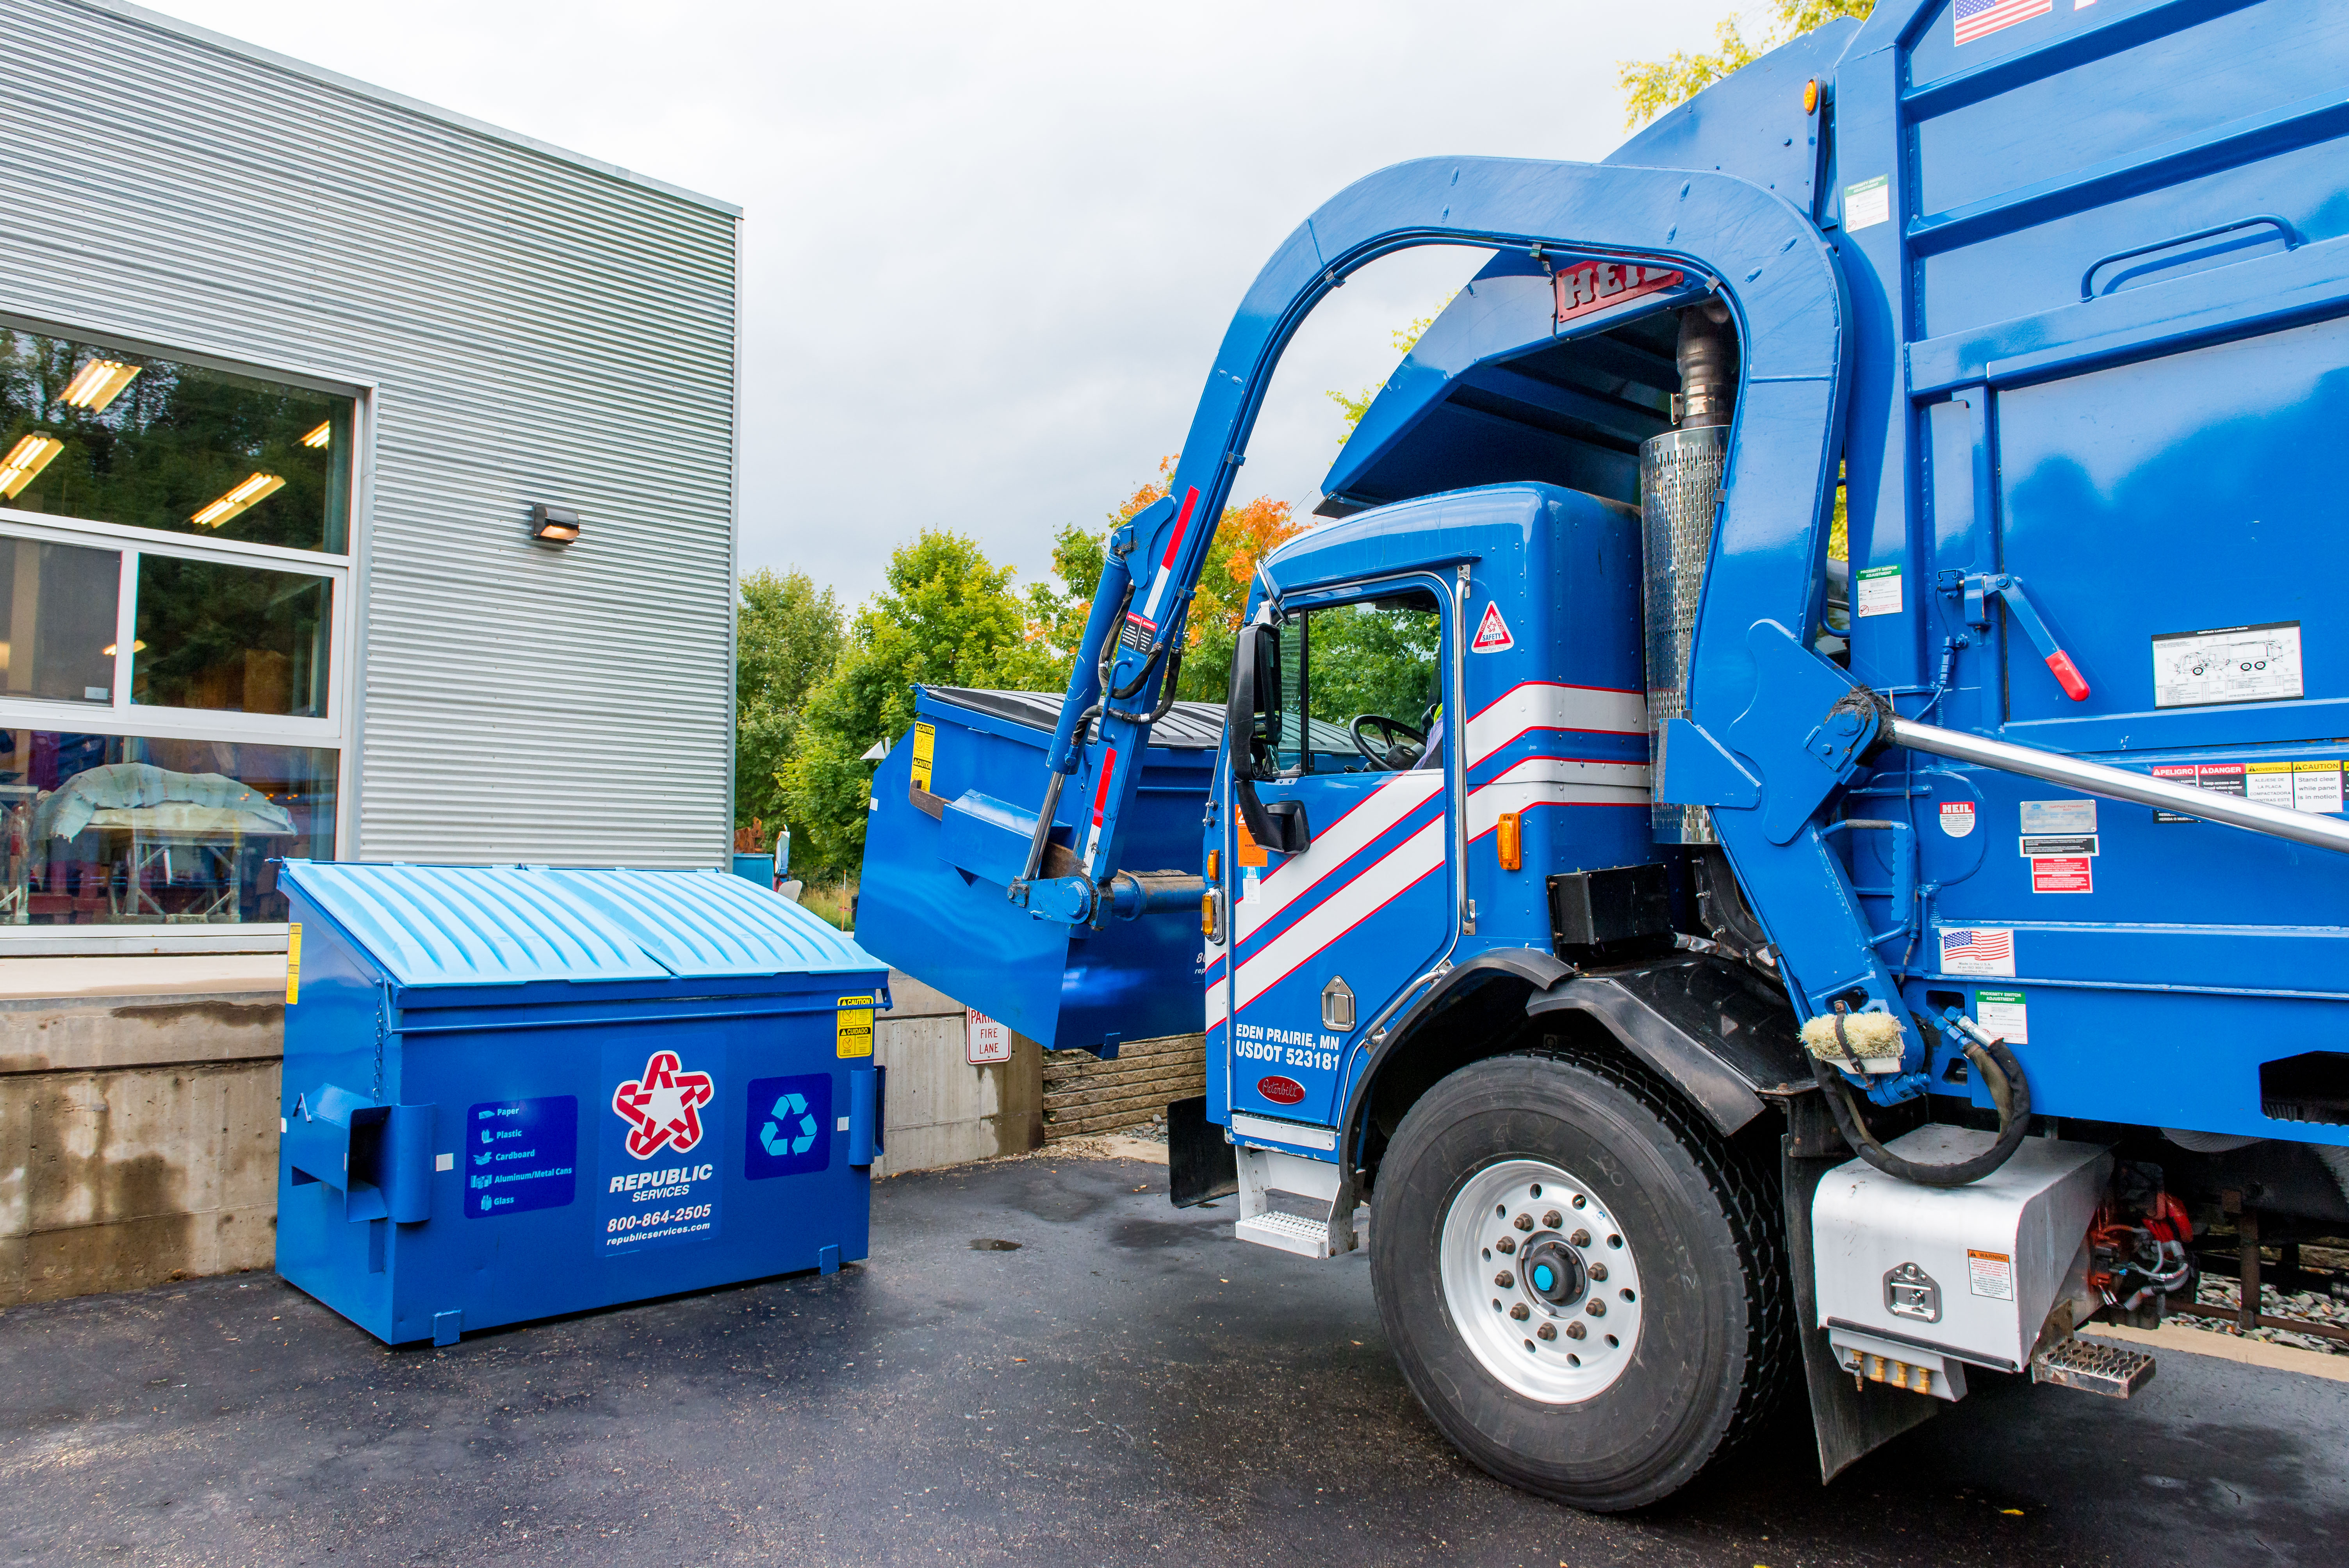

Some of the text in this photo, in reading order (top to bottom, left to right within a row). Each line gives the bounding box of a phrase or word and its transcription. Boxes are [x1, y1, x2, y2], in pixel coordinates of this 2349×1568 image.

[1494, 615, 1505, 633] CHOOSE
[1483, 633, 1501, 641] SAFETY
[920, 725, 934, 734] CAUTION
[917, 758, 931, 769] CAUTION
[1942, 804, 1972, 813] HEIL
[980, 1028, 998, 1039] FIRE
[1236, 1023, 1339, 1050] EDEN PRAIRIE, MN
[979, 1043, 999, 1054] LANE
[1235, 1040, 1340, 1071] USDOT 523181
[1262, 1079, 1300, 1097] Peterbilt
[497, 1108, 519, 1117] Paper
[496, 1130, 522, 1139] Plastic
[495, 1149, 535, 1161] Cardboard
[494, 1168, 554, 1183] Aluminum/Metal
[609, 1164, 713, 1193] REPUBLIC
[632, 1184, 690, 1202] SERVICES
[494, 1197, 514, 1205] Glass
[607, 1203, 712, 1233] 800-864-2505
[607, 1222, 710, 1245] republicservices.com
[1979, 1253, 2007, 1261] WARNING
